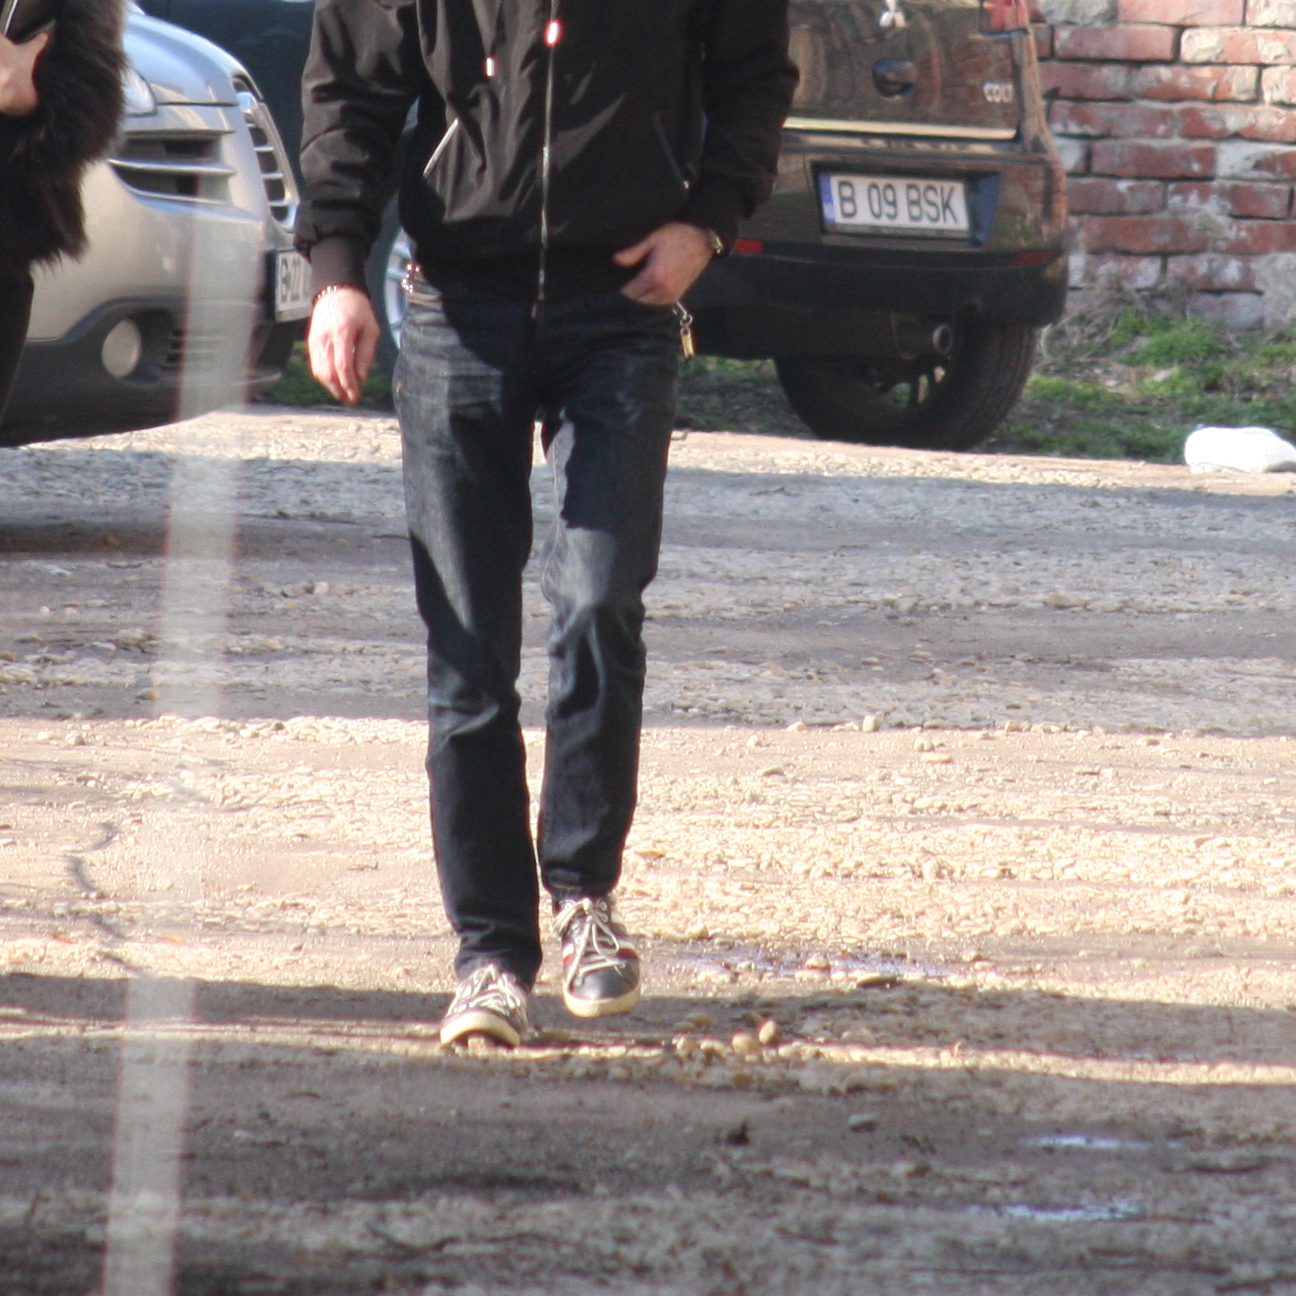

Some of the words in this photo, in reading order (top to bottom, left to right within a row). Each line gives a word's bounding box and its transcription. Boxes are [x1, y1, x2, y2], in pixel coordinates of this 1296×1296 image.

[838, 180, 857, 218] B
[868, 182, 898, 219] 09
[906, 184, 957, 223] BSK
